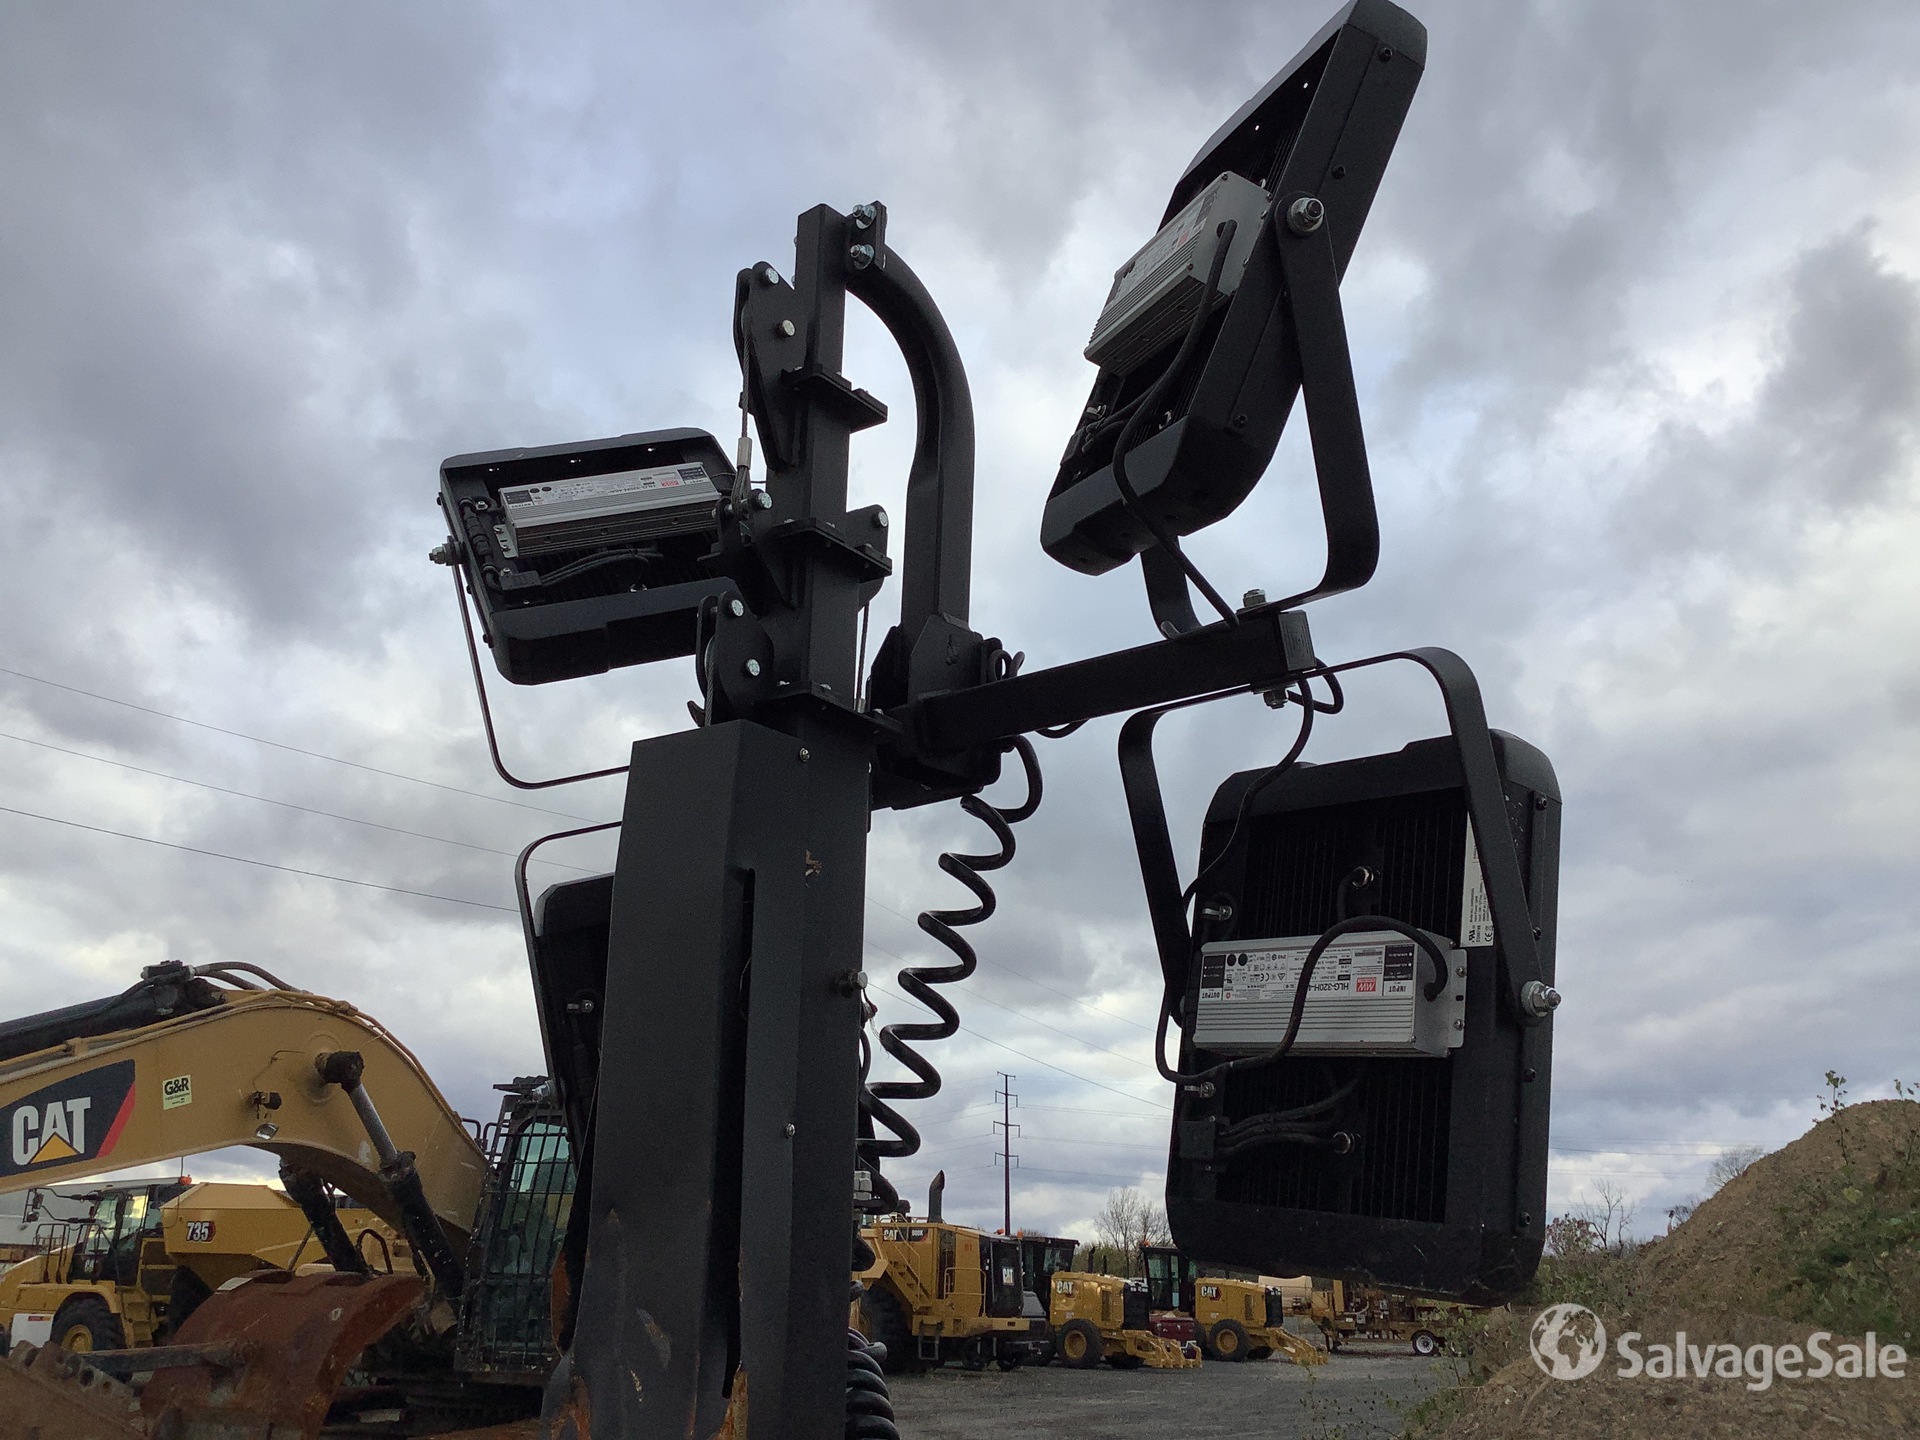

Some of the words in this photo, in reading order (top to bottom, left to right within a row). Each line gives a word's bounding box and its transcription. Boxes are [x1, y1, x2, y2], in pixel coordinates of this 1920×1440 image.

[164, 1077, 189, 1096] G&R
[12, 1096, 91, 1166] CAT
[187, 1221, 209, 1241] 735
[883, 1229, 898, 1241] CAT
[1002, 1267, 1014, 1284] CAT
[1056, 1281, 1074, 1294] CAT
[1200, 1285, 1217, 1298] CAT
